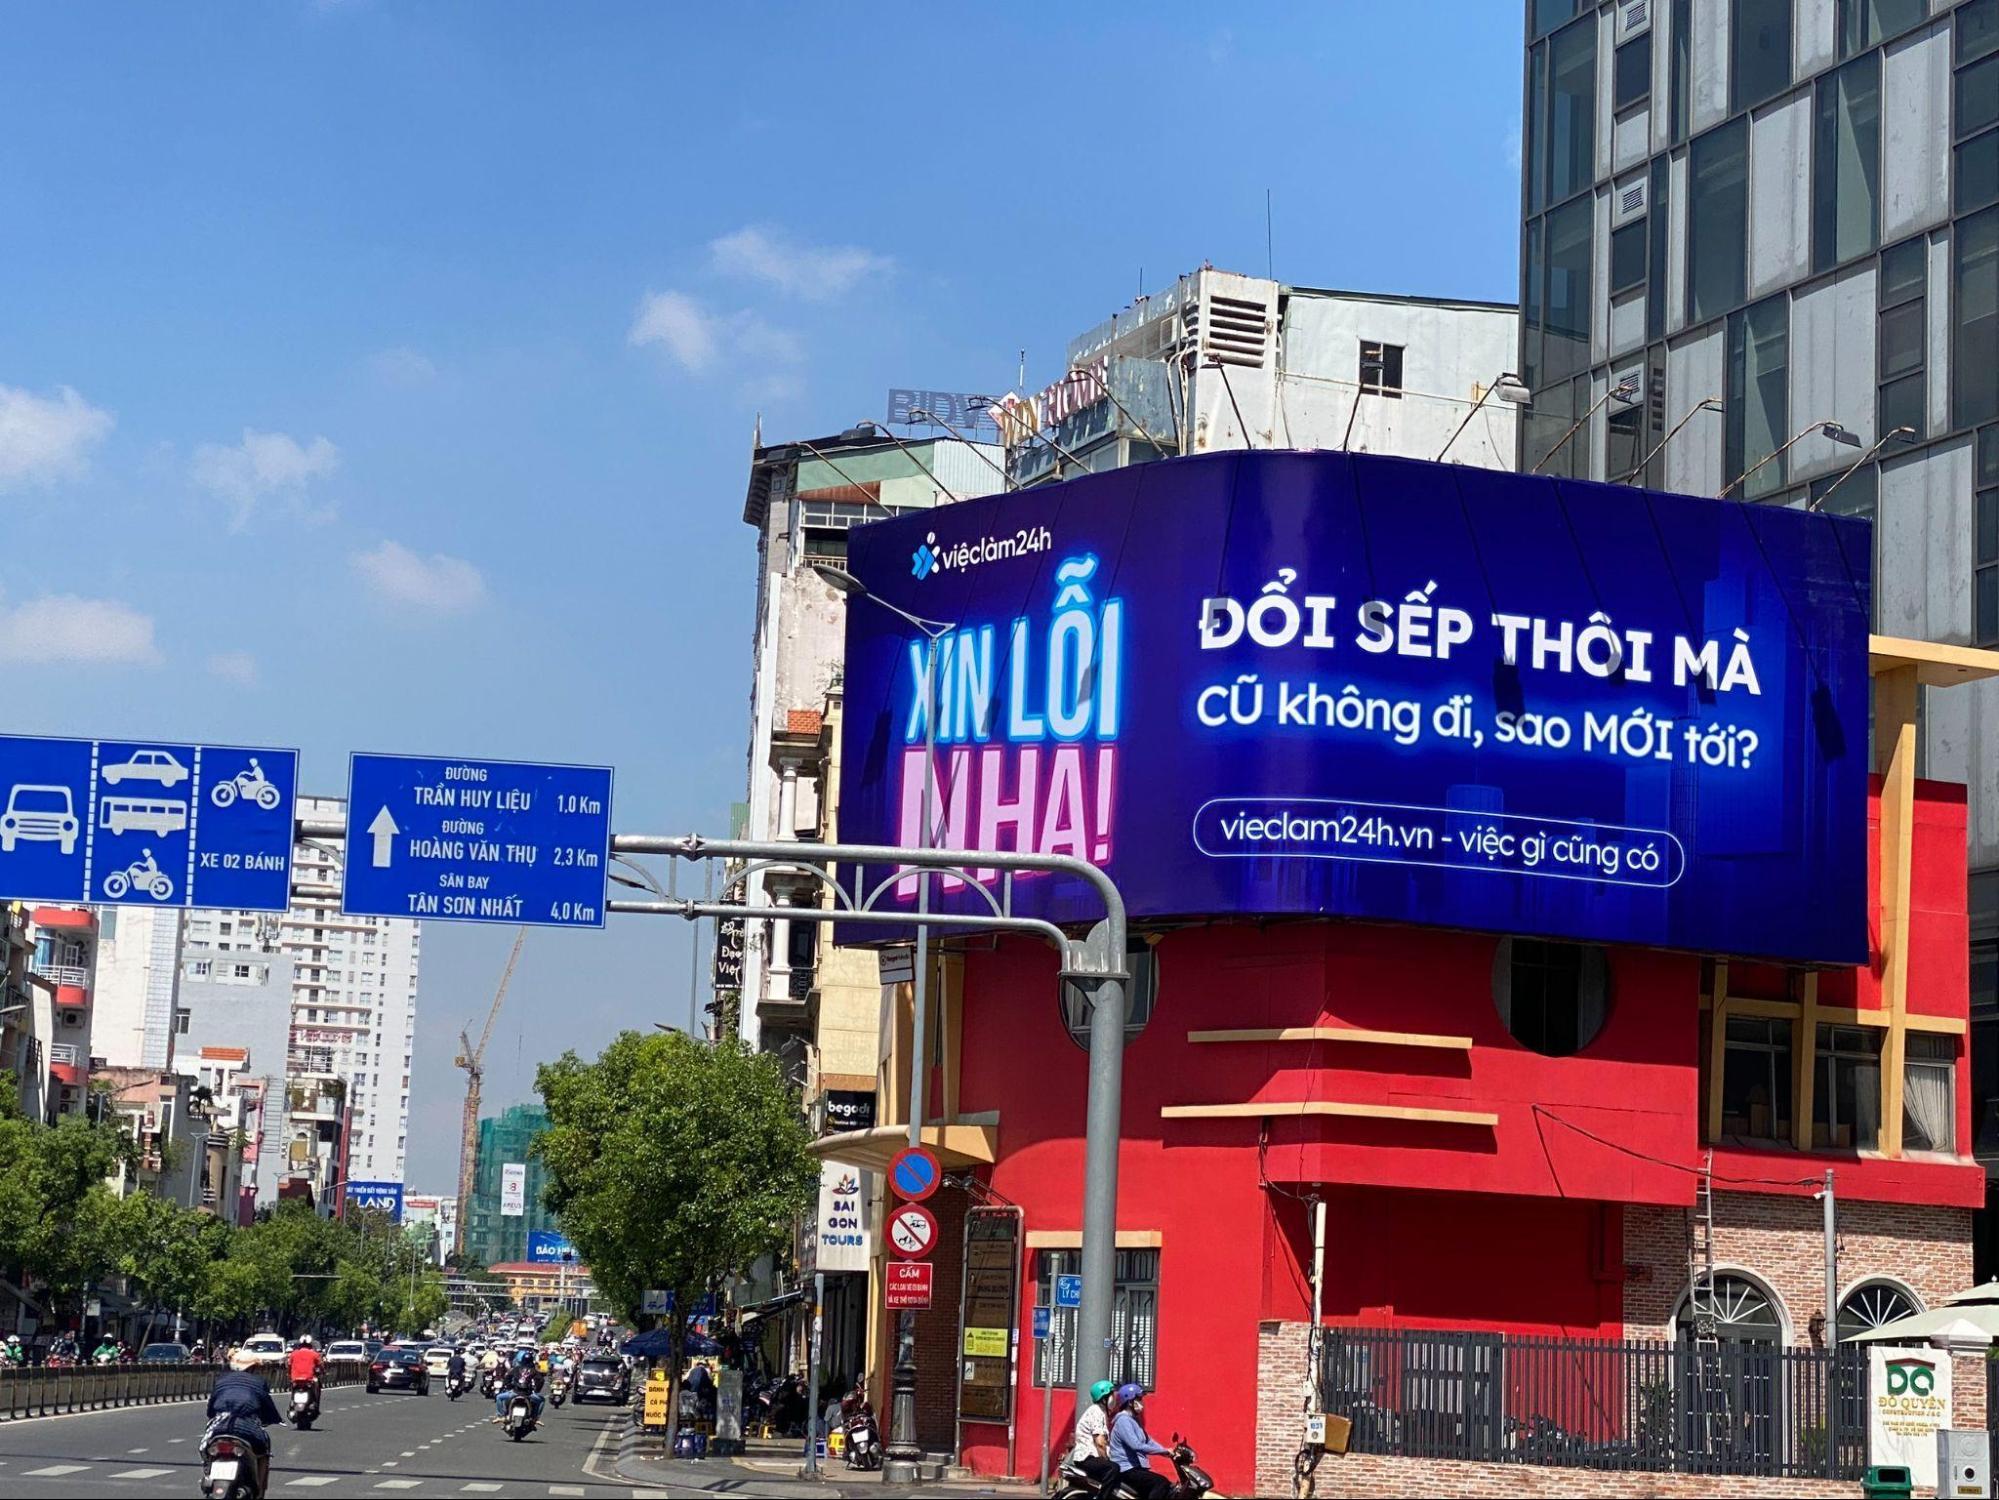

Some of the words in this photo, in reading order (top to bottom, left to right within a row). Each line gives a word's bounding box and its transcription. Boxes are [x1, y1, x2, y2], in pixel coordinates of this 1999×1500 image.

[942, 527, 1052, 573] việclàm24h
[1199, 568, 1336, 650] ĐỔI
[1355, 580, 1474, 660] SẾP
[1491, 612, 1653, 683] THÔI
[1673, 628, 1762, 695] MÀ
[907, 627, 994, 741] XIN
[1008, 555, 1121, 739] LỖI
[1197, 675, 1264, 727] CŨ
[1278, 683, 1421, 745] không
[1432, 695, 1484, 748] đi,
[1495, 711, 1571, 748] sao
[1583, 706, 1674, 761] MỚI
[1684, 723, 1760, 769] tới?
[445, 766, 487, 782] ĐƯỜNG
[414, 785, 455, 806] TRẦN
[460, 789, 492, 808] HUY
[496, 791, 531, 811] LIỆU
[557, 796, 576, 813] 1,0
[579, 797, 600, 814] Km
[441, 819, 484, 835] ĐƯỜNG
[897, 745, 1118, 899] NHA!
[1220, 812, 1434, 850] vieclam24h.vn
[1459, 826, 1515, 860] việc
[1521, 832, 1547, 867] gì
[1552, 838, 1619, 872] cũng
[1626, 843, 1660, 871] có
[410, 839, 464, 860] HOÀNG
[469, 843, 499, 861] VĂN
[506, 845, 537, 865] THỤ
[554, 848, 574, 866] 2,3
[577, 850, 598, 867] Km
[200, 853, 219, 868] XE
[223, 855, 241, 869] 02
[244, 854, 285, 872] BÁNH
[439, 873, 464, 888] SÂN
[467, 877, 489, 889] BAY
[407, 894, 438, 913] TÂN
[443, 897, 476, 915] SƠN
[479, 894, 523, 917] NHẤT
[550, 905, 570, 920] 4,0
[573, 906, 594, 921] Km
[357, 1195, 396, 1212] LAND
[833, 1201, 855, 1212] SAI
[828, 1217, 857, 1229] GON
[821, 1234, 863, 1246] TOURS
[899, 1266, 920, 1278] CẤM
[1901, 1395, 1945, 1410] QUYÊN
